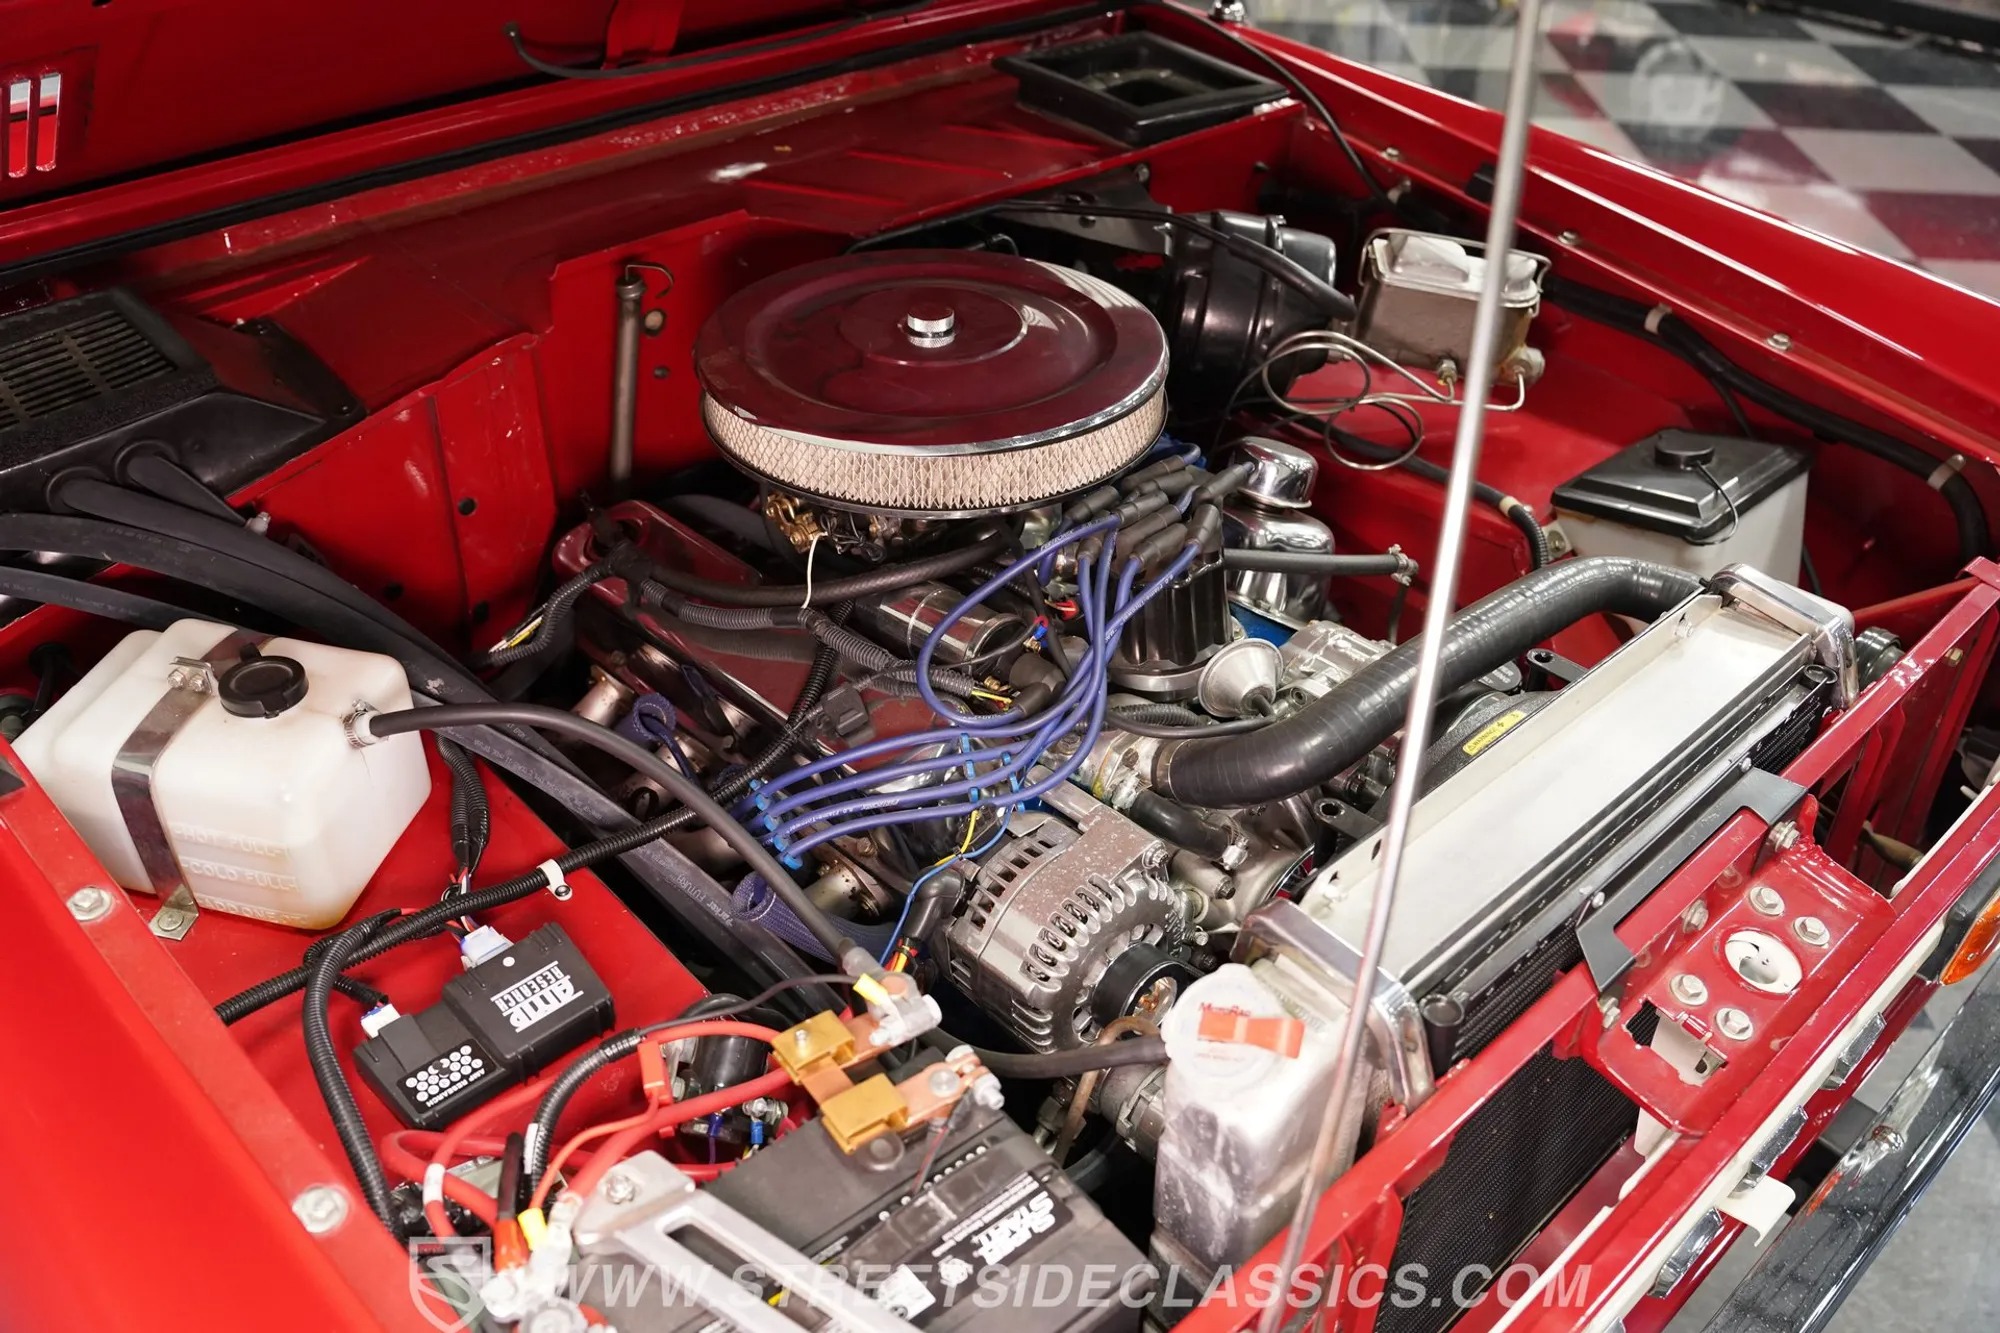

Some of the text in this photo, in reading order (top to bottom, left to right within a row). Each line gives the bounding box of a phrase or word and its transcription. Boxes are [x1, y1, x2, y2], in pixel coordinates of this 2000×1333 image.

[494, 966, 564, 1012] RESEARCH
[502, 975, 584, 1033] AMP
[425, 1068, 486, 1108] AMP RESEARCH
